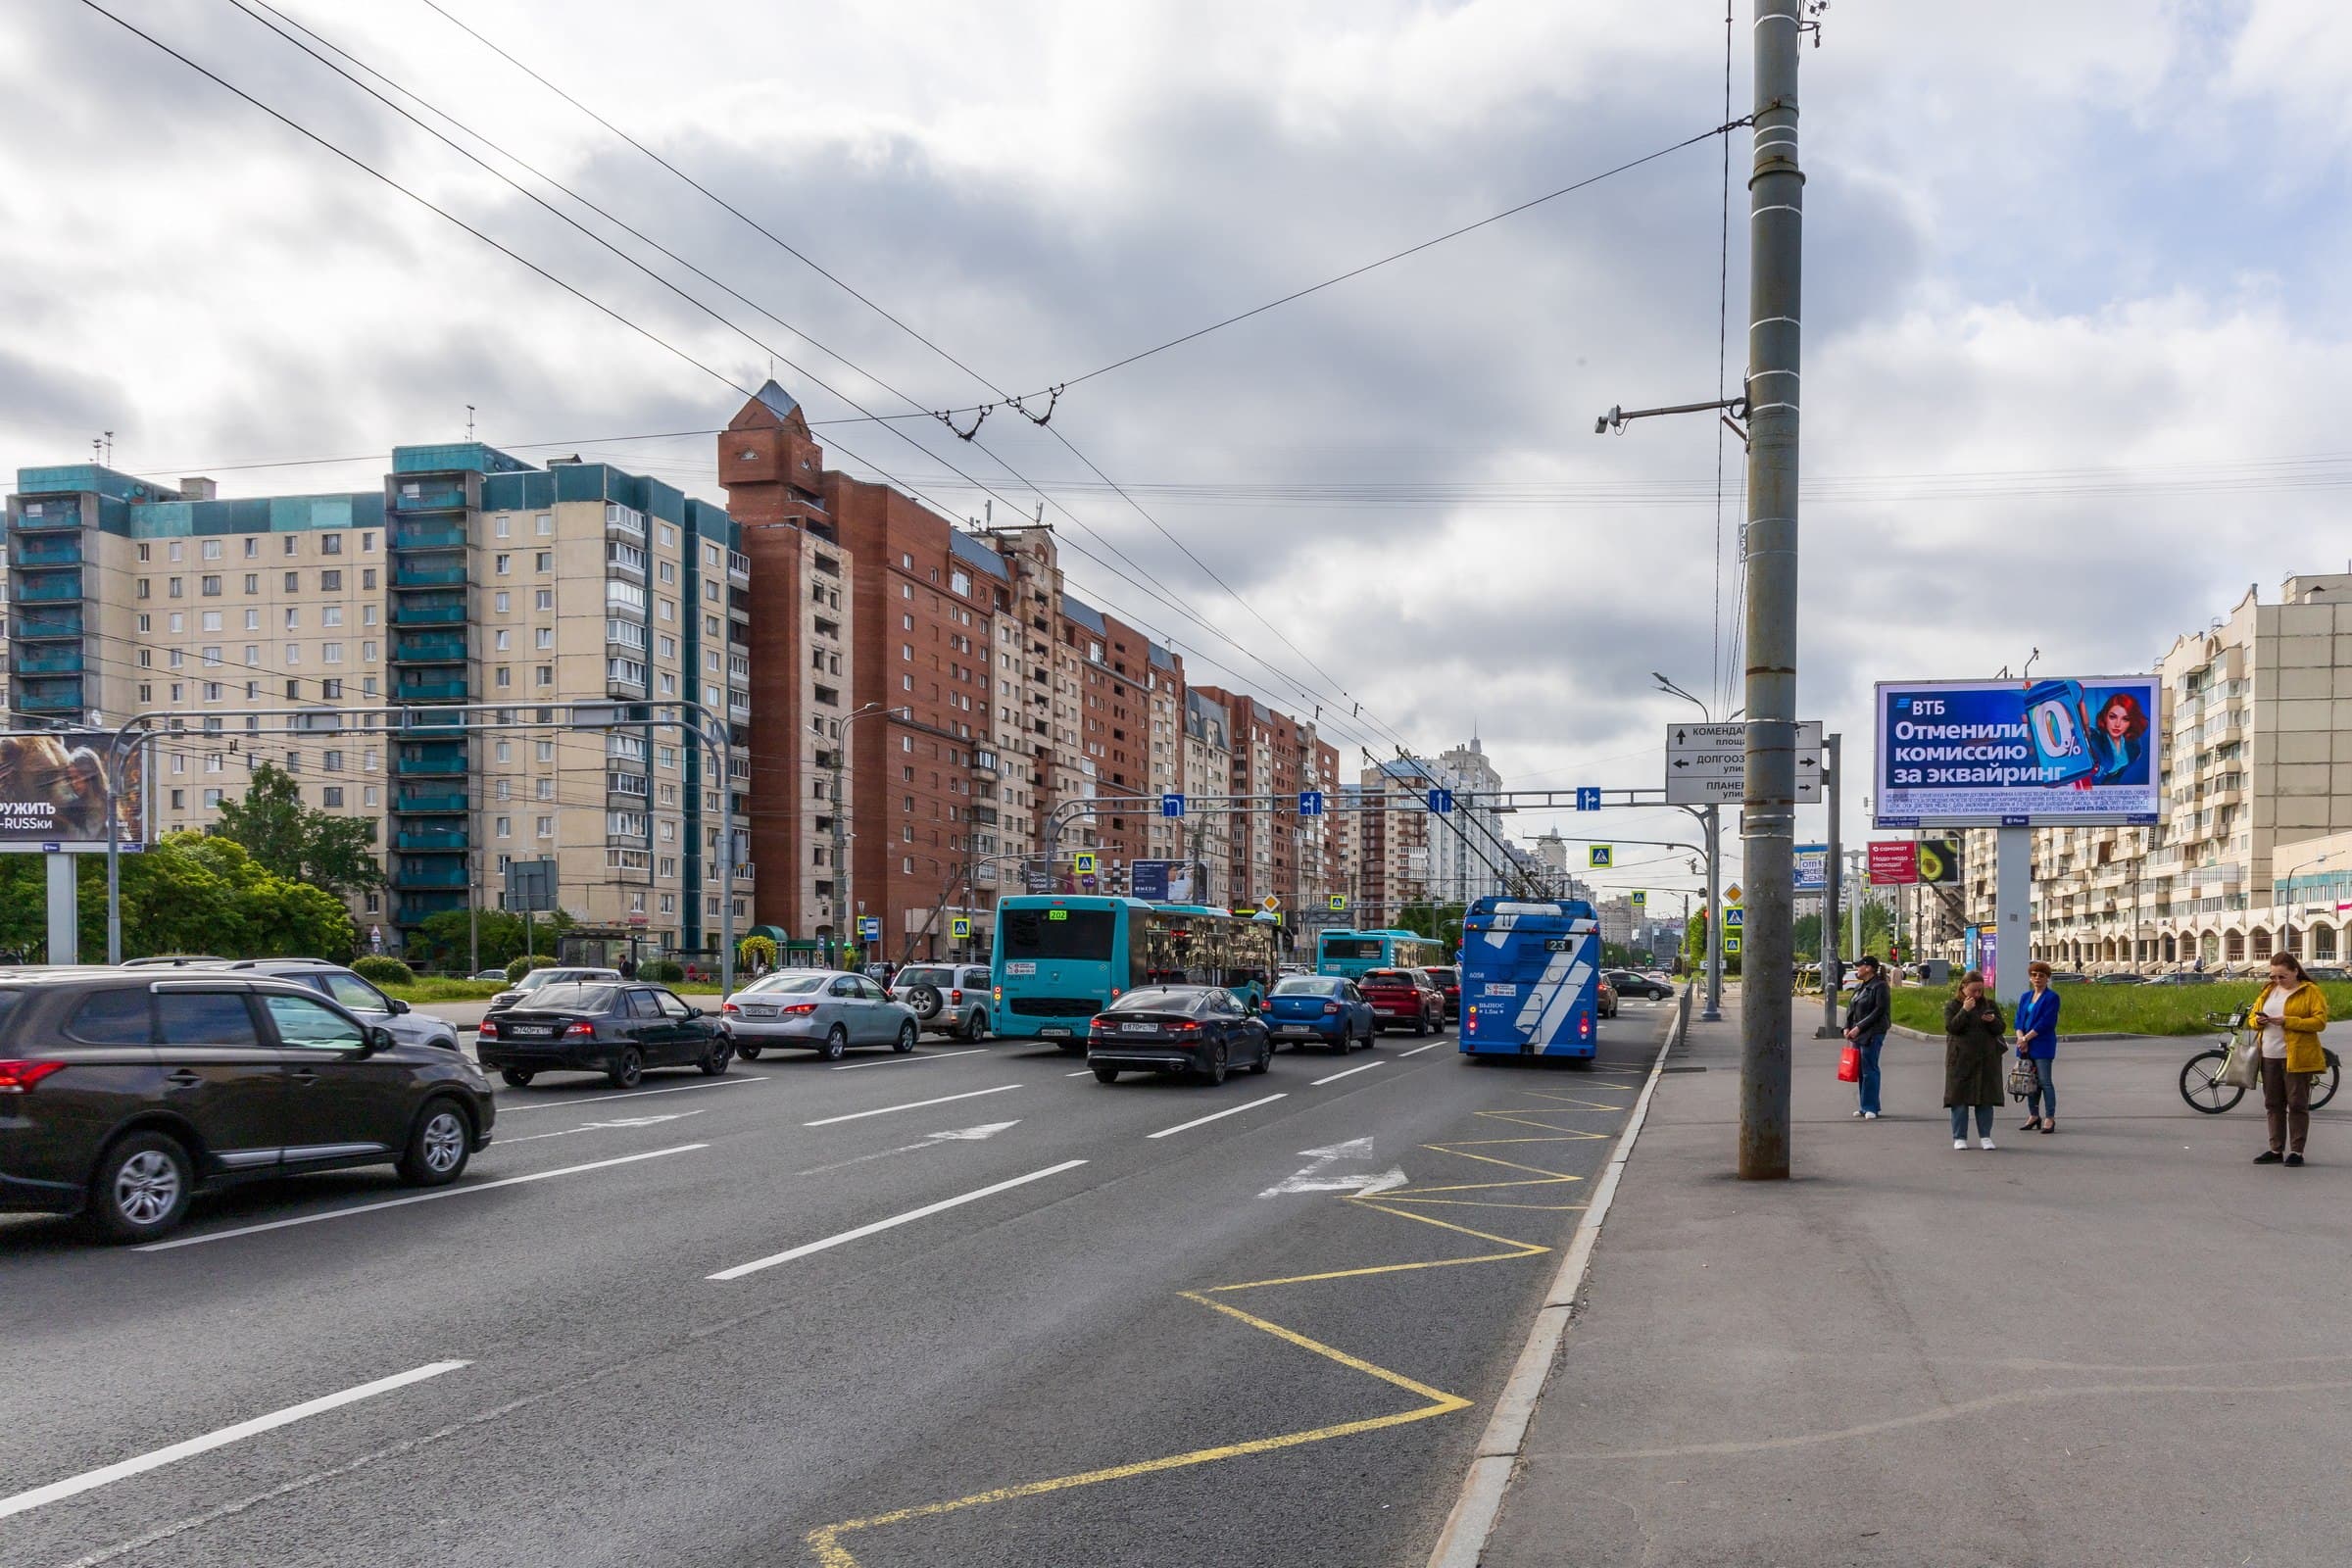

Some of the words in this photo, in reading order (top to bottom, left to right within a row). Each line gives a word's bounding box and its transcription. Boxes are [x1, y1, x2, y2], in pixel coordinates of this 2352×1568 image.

[1912, 701, 1945, 715] ВТБ
[1895, 721, 2028, 740] Отменили
[1895, 745, 2028, 761] комиссию
[1894, 768, 1922, 783] за
[1927, 762, 2067, 786] эквайринг
[1051, 910, 1066, 919] 202
[1549, 940, 1567, 951] 23
